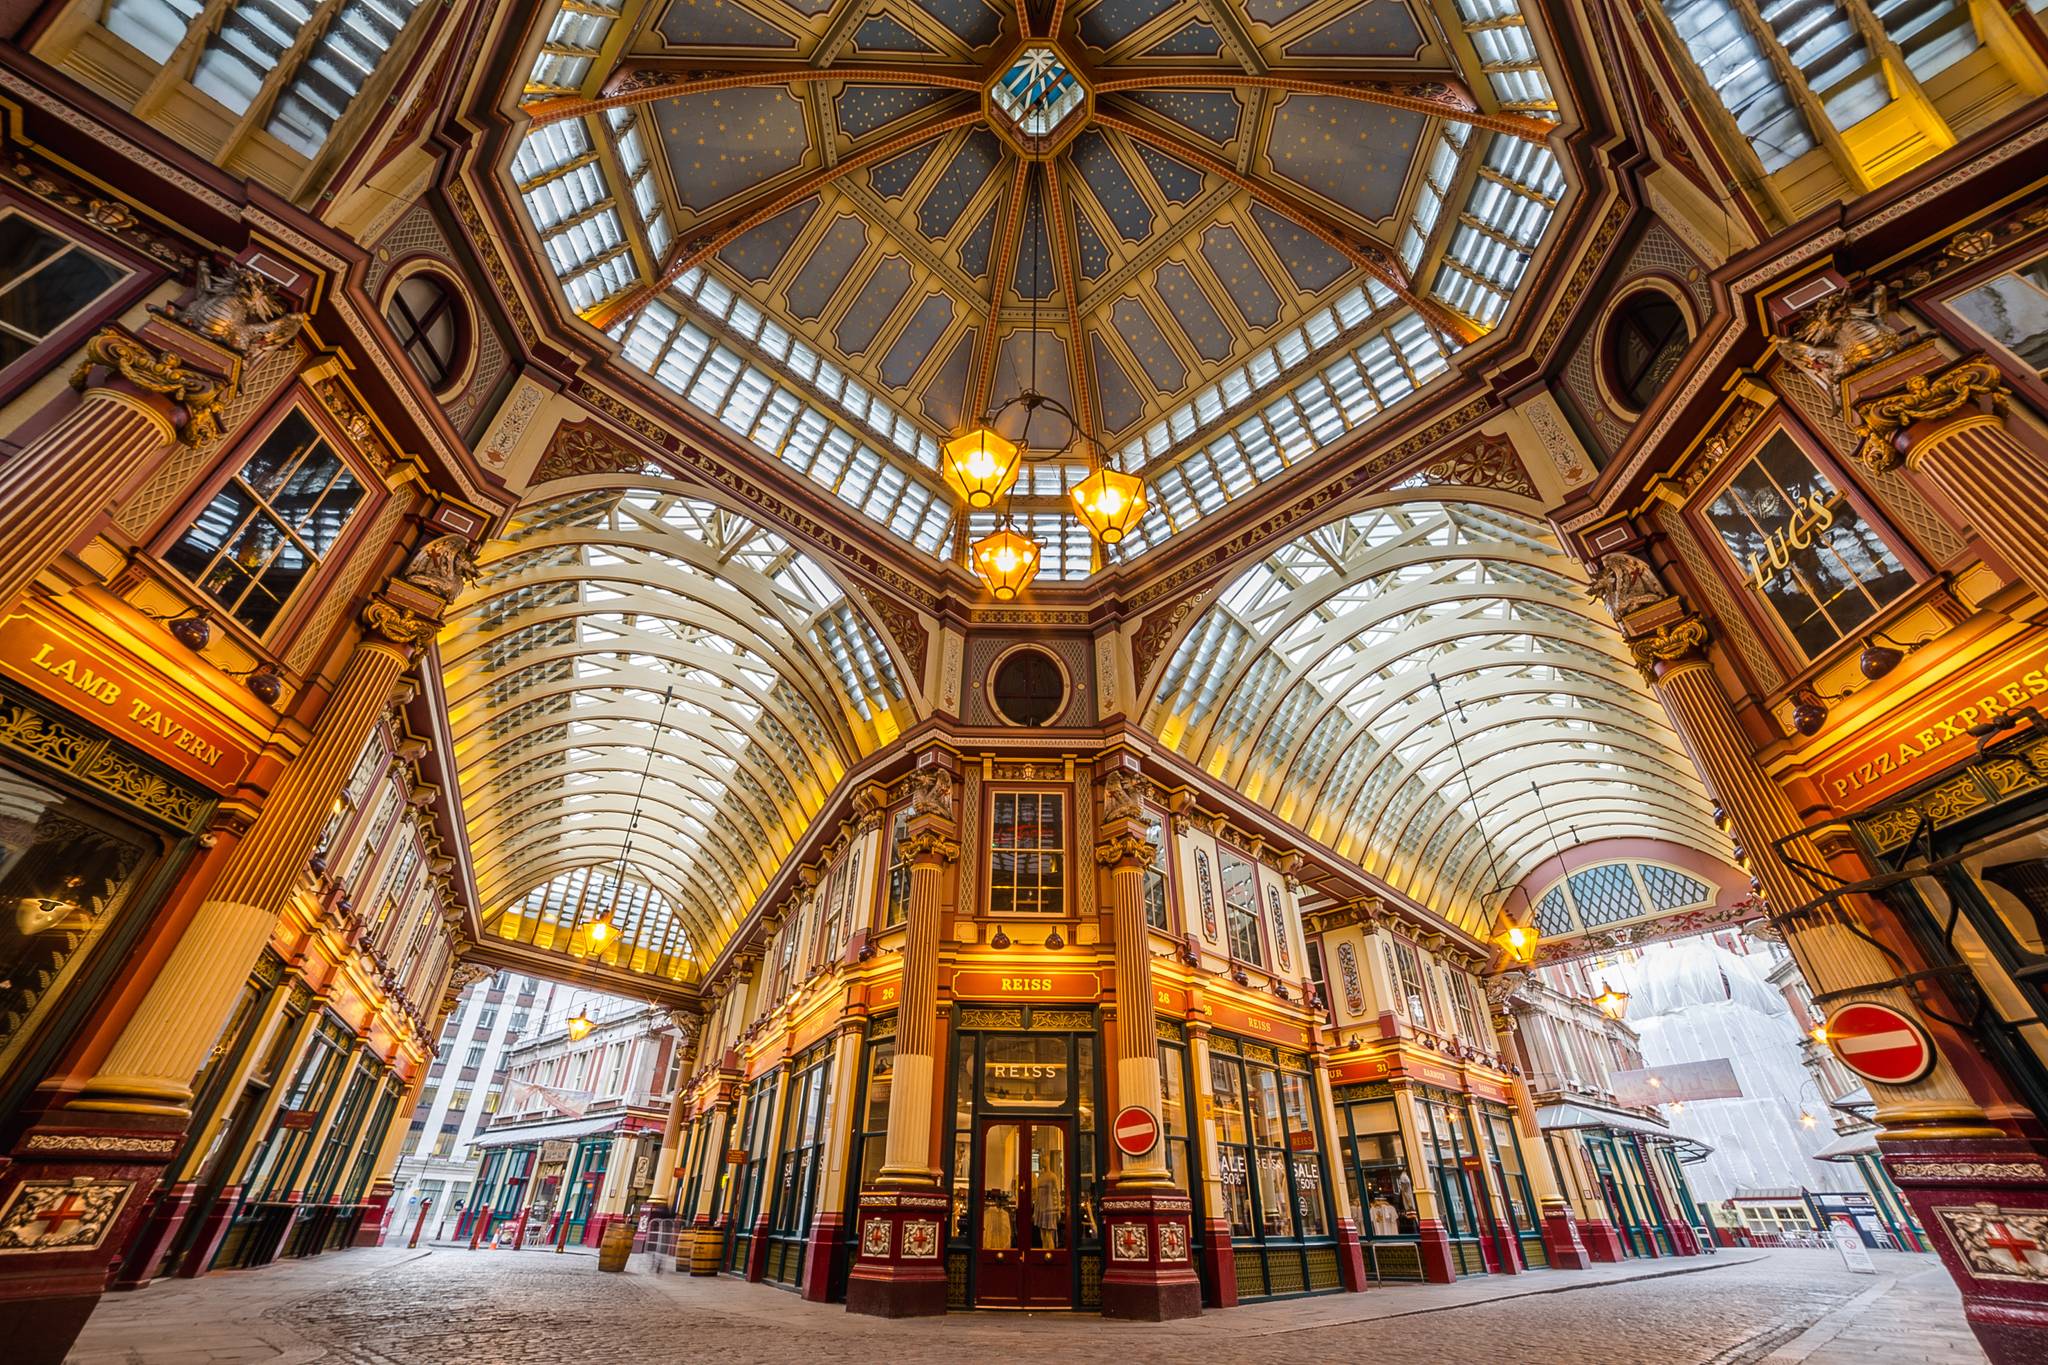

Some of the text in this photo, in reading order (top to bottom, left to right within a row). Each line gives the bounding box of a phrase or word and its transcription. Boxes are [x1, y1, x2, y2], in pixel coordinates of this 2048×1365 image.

[1748, 489, 1833, 590] LUC'S
[31, 643, 224, 767] LAMB TAVERN
[1832, 662, 2048, 798] PIZZAEXPRES
[1001, 978, 1053, 992] REISS
[882, 987, 895, 1000] 26
[1158, 991, 1170, 1004] 26
[1248, 1017, 1272, 1032] REISS
[995, 1065, 1057, 1078] REISS
[1376, 1063, 1388, 1073] 31
[1221, 1155, 1246, 1173] ALE
